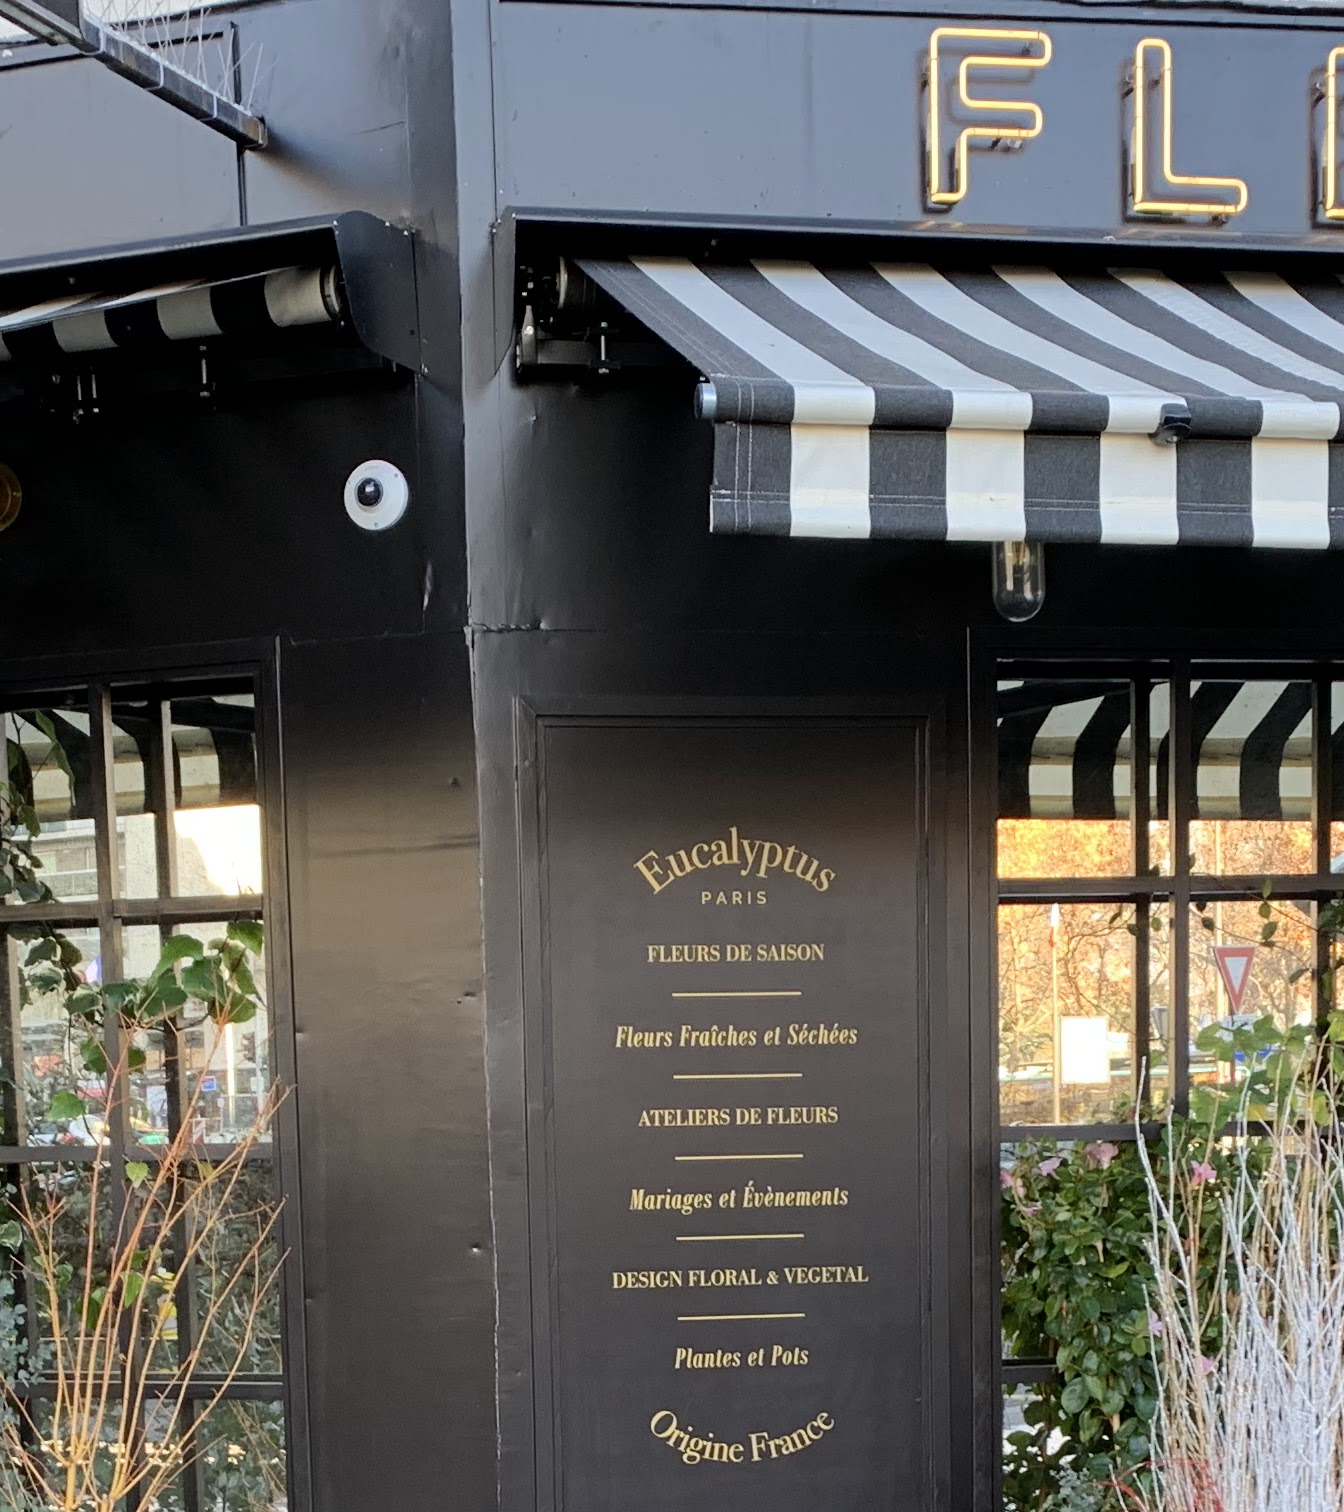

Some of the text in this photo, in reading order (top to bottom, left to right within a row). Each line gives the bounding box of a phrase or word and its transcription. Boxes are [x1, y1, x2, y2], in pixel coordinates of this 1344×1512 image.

[633, 826, 836, 895] Eucalyptus
[700, 890, 768, 905] PARIS
[647, 943, 825, 963] FLEURS DE SAISON
[615, 1023, 858, 1048] Fleurs Fraîches et Séchées
[638, 1106, 839, 1127] ATELIERS DE FLEURS
[629, 1180, 849, 1215] Mariages et Évènements
[612, 1266, 869, 1289] DESIGN FLORAL & VEGETAL
[674, 1345, 809, 1369] Plantes et Pots
[650, 1410, 835, 1465] Origine France
